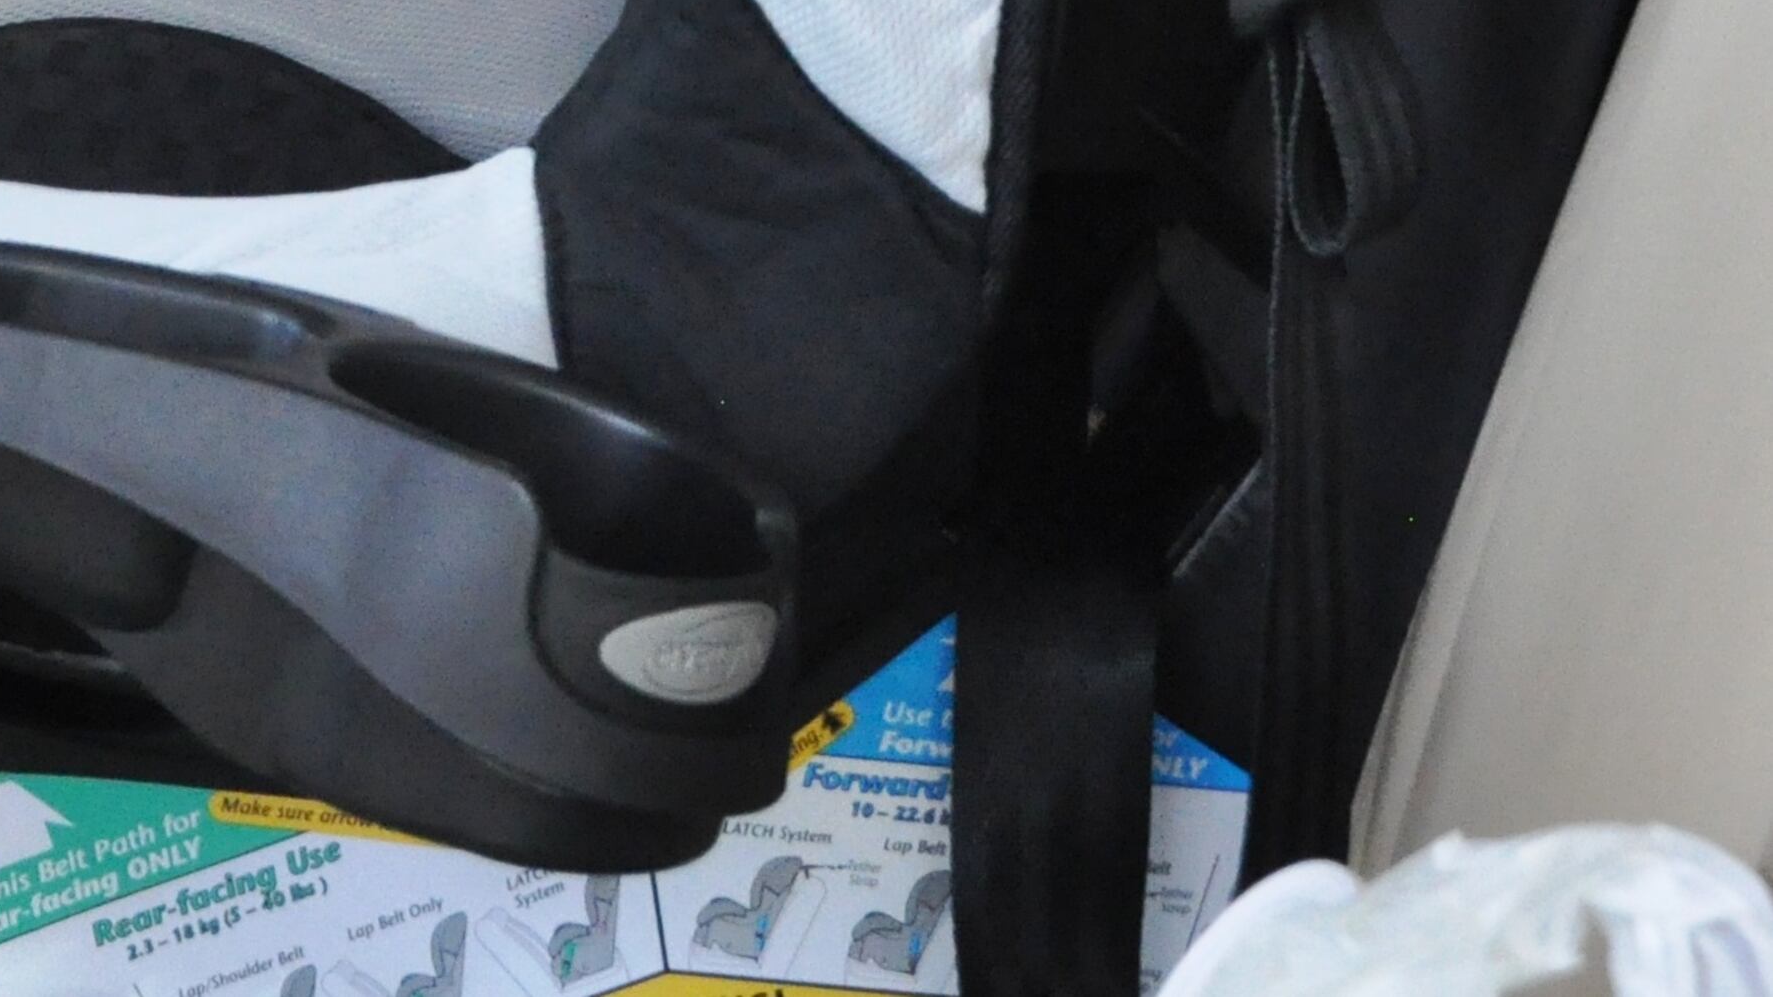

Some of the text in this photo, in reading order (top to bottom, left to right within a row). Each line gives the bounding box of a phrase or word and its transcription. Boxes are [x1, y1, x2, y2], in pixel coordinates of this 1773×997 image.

[882, 701, 932, 727] Use
[802, 761, 952, 801] Forward
[221, 797, 270, 818] Make
[276, 805, 314, 823] sure
[851, 801, 875, 819] 10
[37, 850, 88, 884] Belt
[94, 822, 156, 862] Path
[163, 809, 202, 838] for
[722, 821, 834, 845] LATCH System
[883, 837, 912, 856] Lap
[127, 835, 202, 881] ONLY
[92, 841, 342, 947] Rear-facing Use
[514, 881, 566, 909] System
[173, 921, 195, 943] 18
[198, 917, 221, 936] kg
[346, 897, 444, 942] Lap Belt Only
[178, 946, 305, 997] Lap/Shoulder Belt
